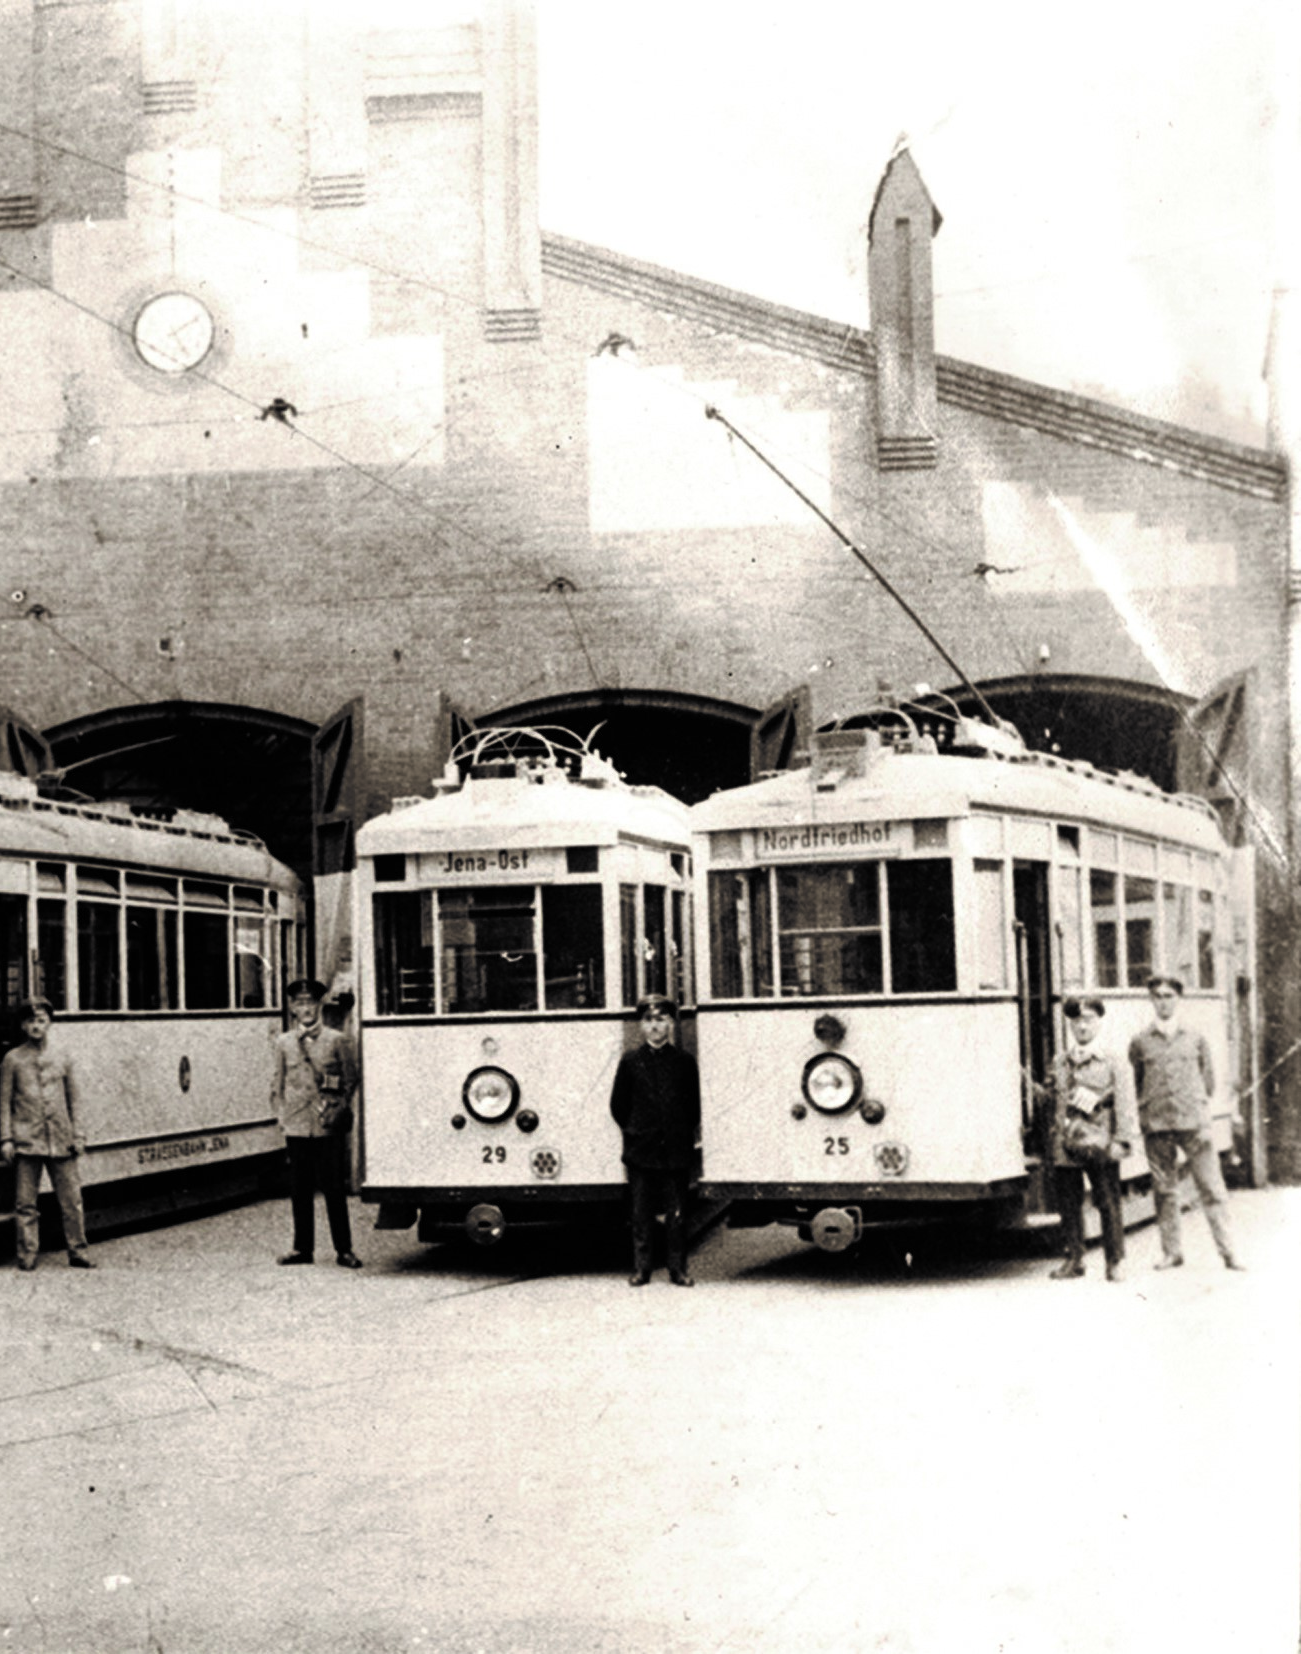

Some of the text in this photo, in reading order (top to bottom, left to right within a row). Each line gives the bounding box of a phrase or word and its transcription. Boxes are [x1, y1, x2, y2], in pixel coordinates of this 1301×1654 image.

[763, 819, 891, 850] Nordfriedhof
[443, 849, 529, 872] Jena-Ost
[482, 1145, 507, 1164] 29
[823, 1136, 850, 1155] 25
